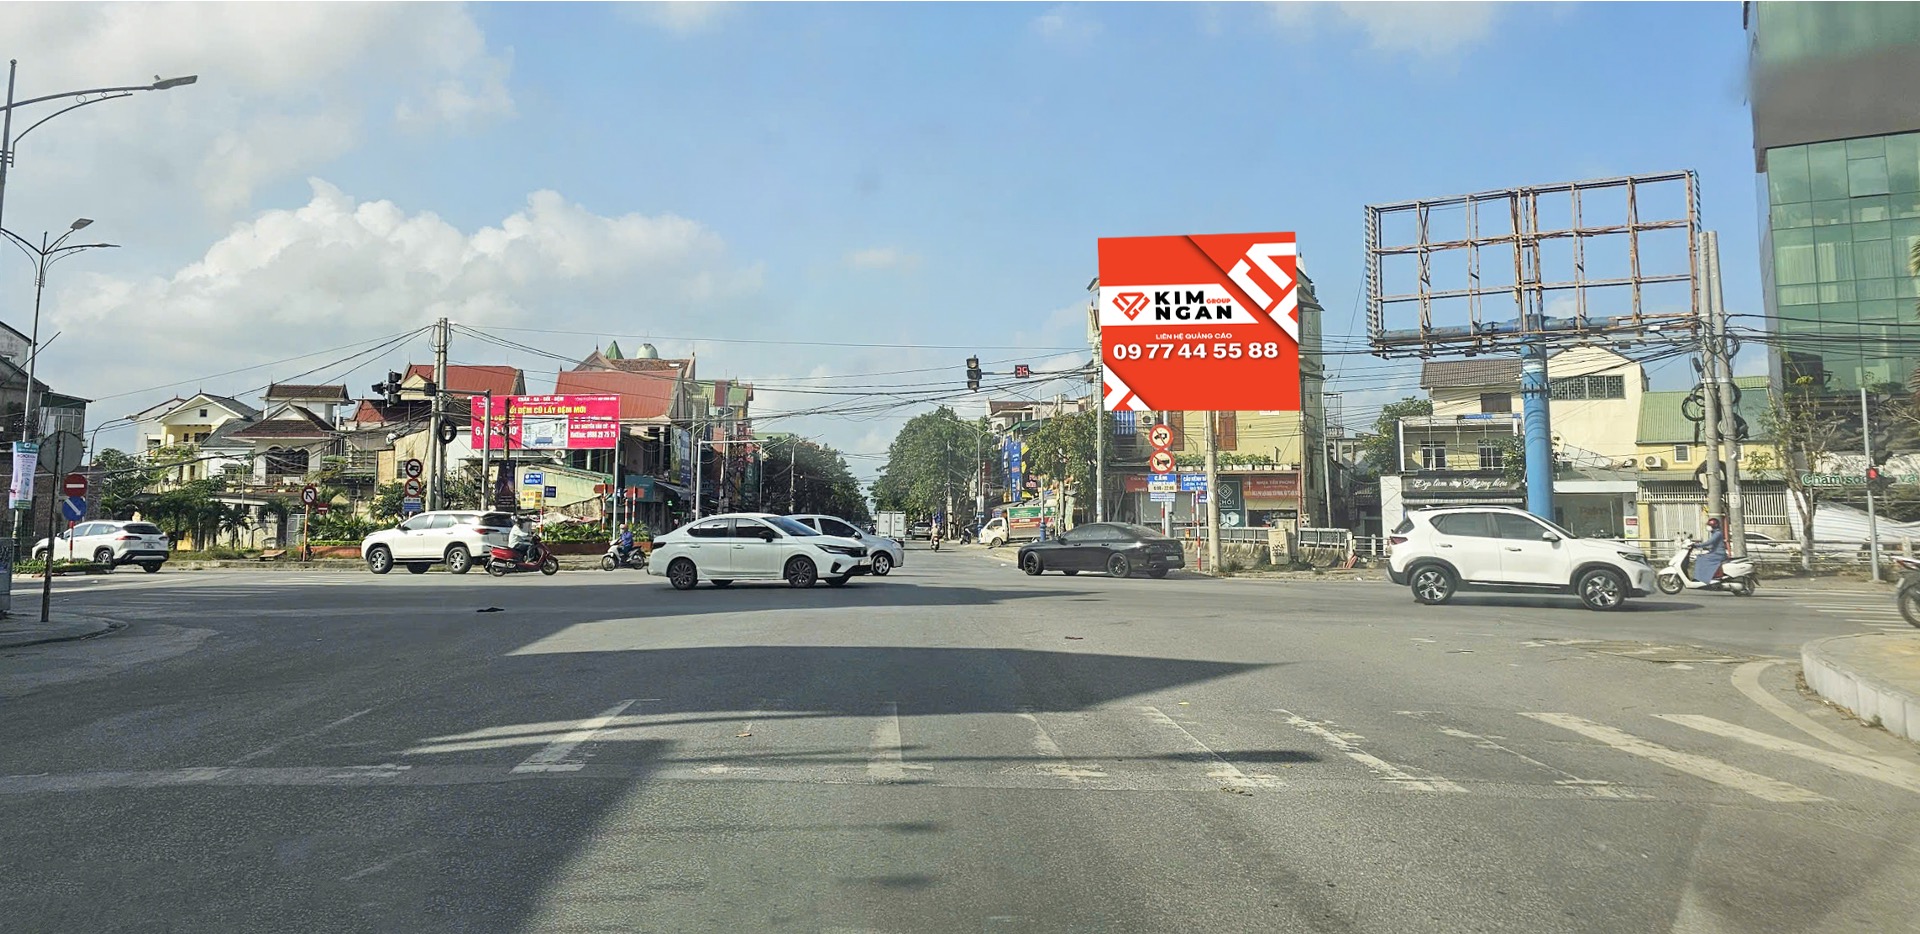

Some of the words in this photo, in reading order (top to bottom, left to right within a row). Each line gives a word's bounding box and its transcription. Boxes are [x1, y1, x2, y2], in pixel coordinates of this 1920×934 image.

[1155, 291, 1204, 305] KIM
[1155, 305, 1232, 320] NGAN
[1155, 332, 1173, 340] LIÊN
[1173, 332, 1184, 341] HỆ
[1185, 331, 1213, 340] QUẢNG
[1214, 331, 1233, 339] CÁO
[1113, 344, 1142, 360] 09
[1146, 344, 1175, 360] 77
[1178, 344, 1207, 360] 44
[1213, 343, 1243, 359] 55
[1248, 342, 1279, 359] 88
[544, 404, 556, 414] LẤY
